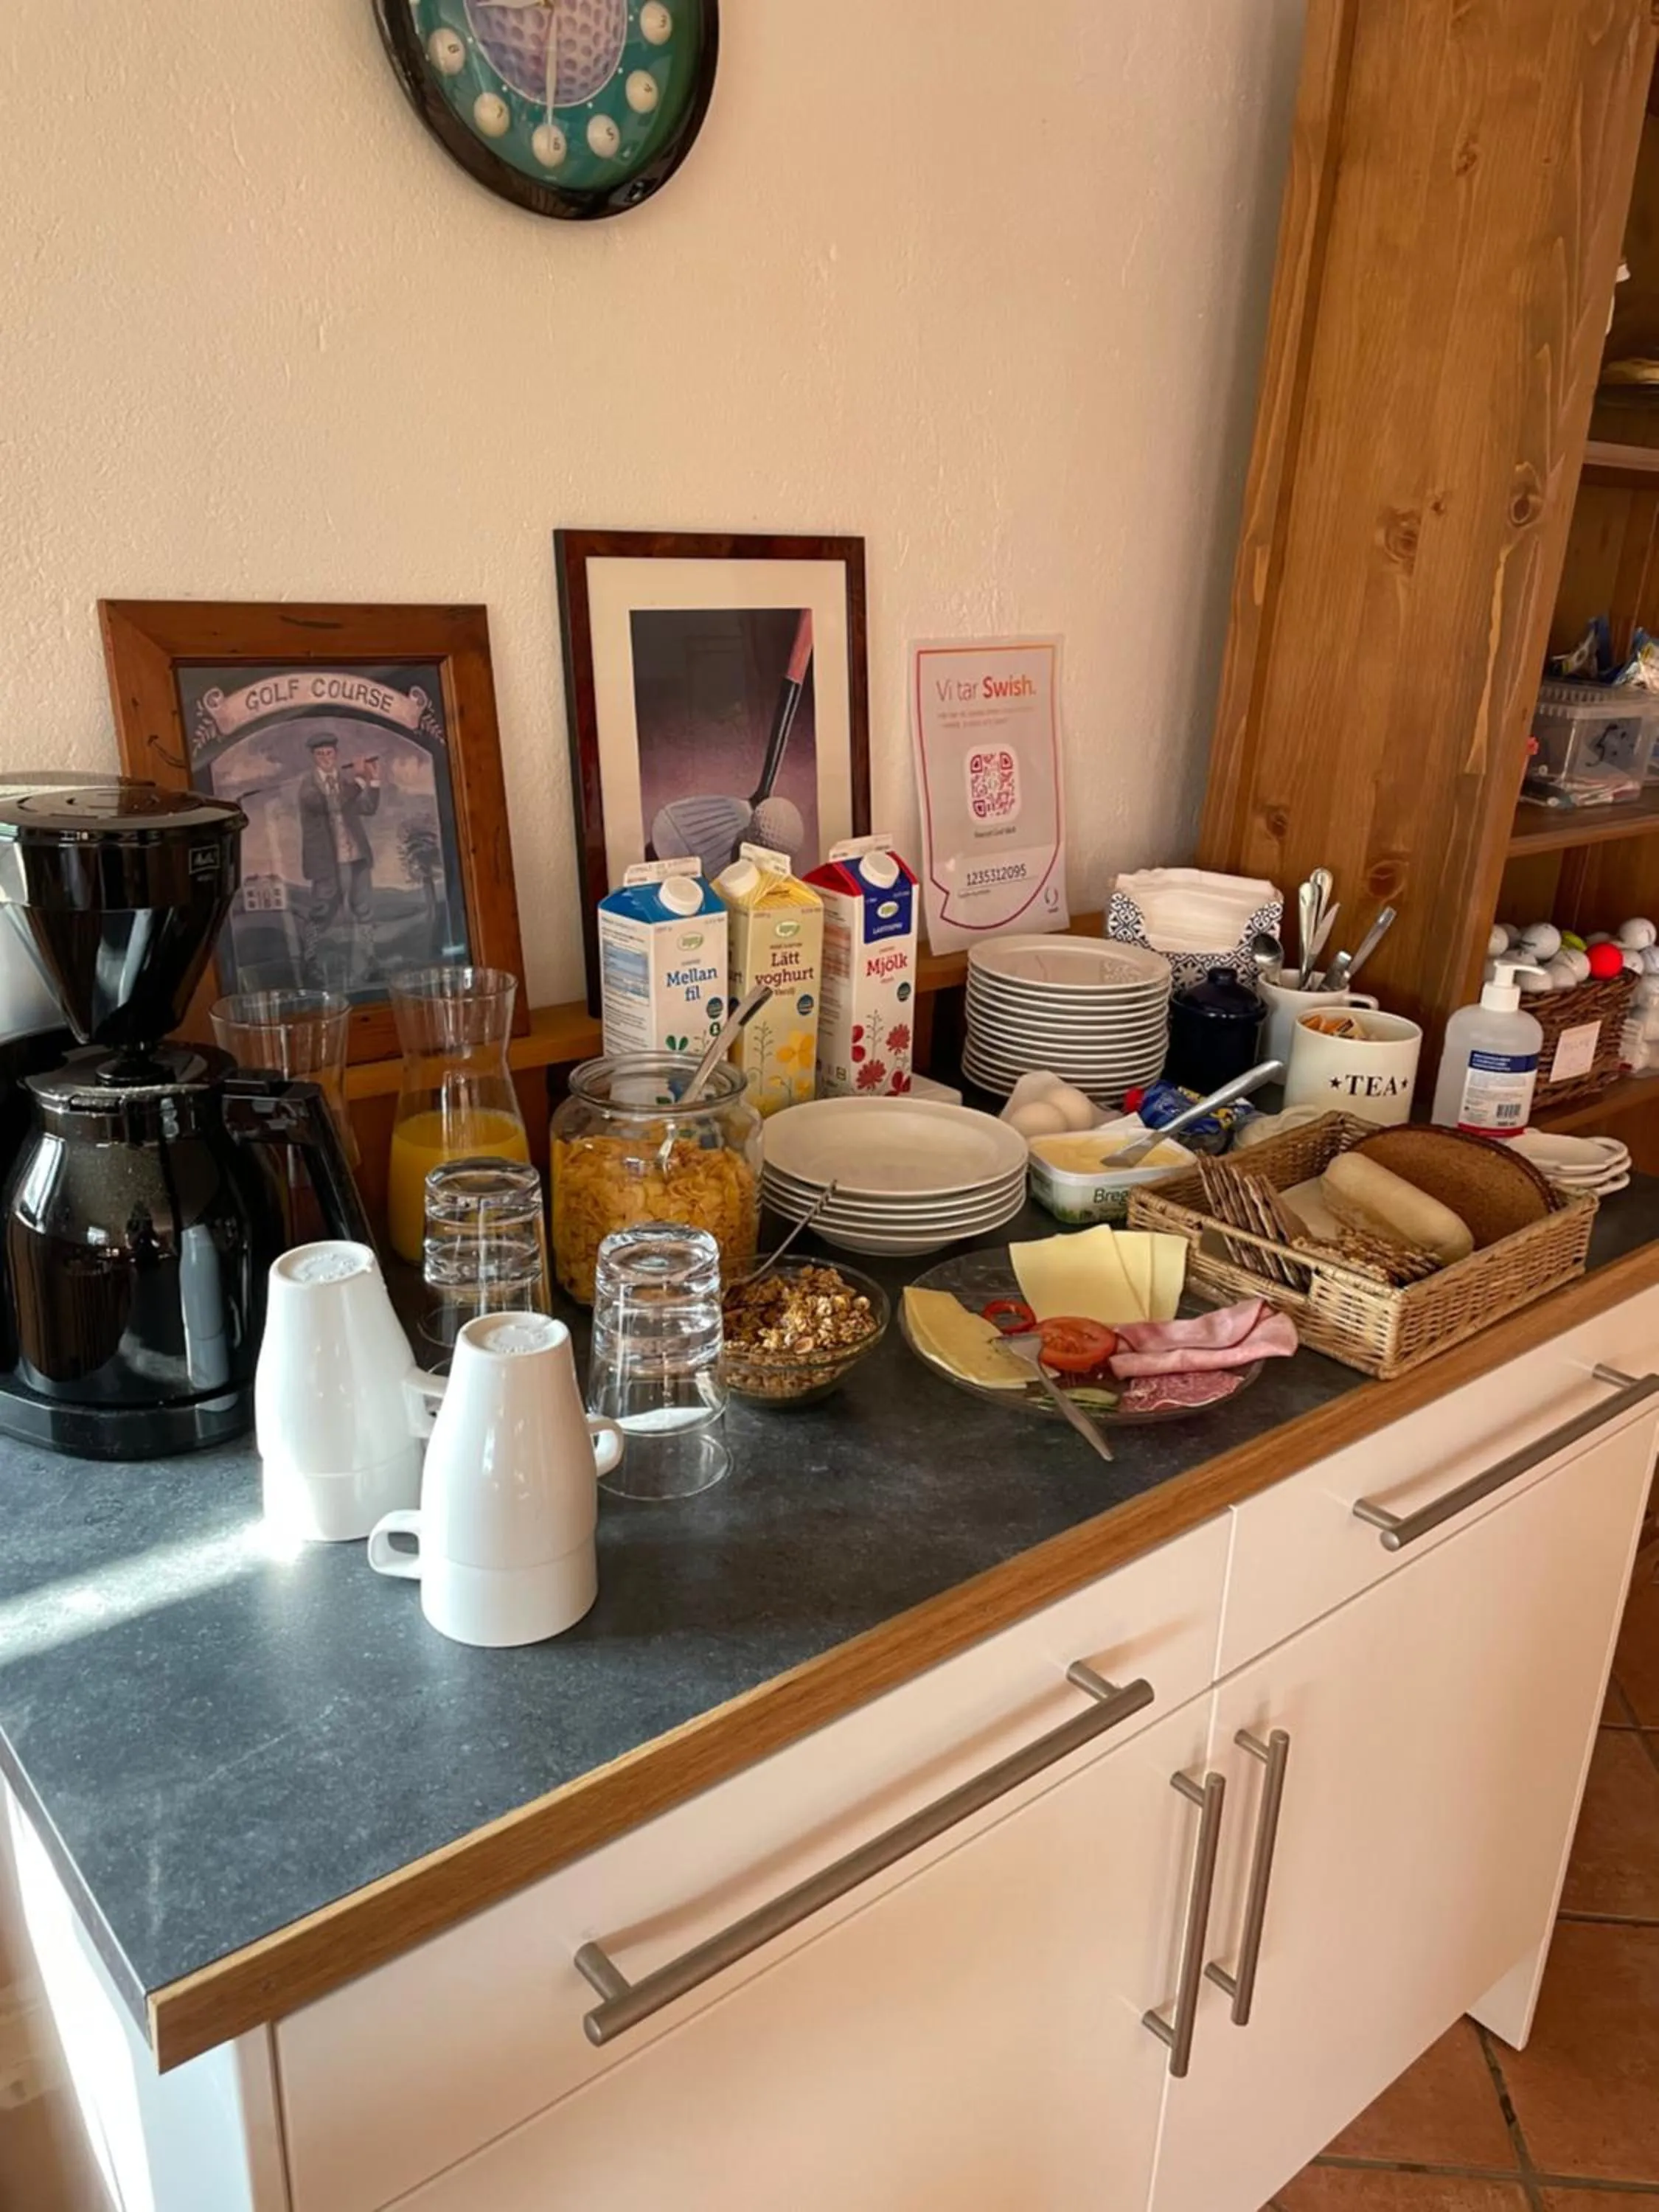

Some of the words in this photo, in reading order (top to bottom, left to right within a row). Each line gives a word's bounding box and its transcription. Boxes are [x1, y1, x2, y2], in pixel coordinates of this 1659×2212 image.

[245, 679, 299, 711] GOLF
[310, 678, 394, 714] COURSE
[936, 678, 953, 702] Vi
[957, 680, 979, 701] tar
[967, 863, 1027, 886] 1235312095
[771, 951, 799, 967] Lätt
[866, 953, 908, 977] Mjölk
[666, 967, 718, 988] Mellan
[684, 985, 700, 1001] fil
[1344, 1074, 1397, 1097] TEA
